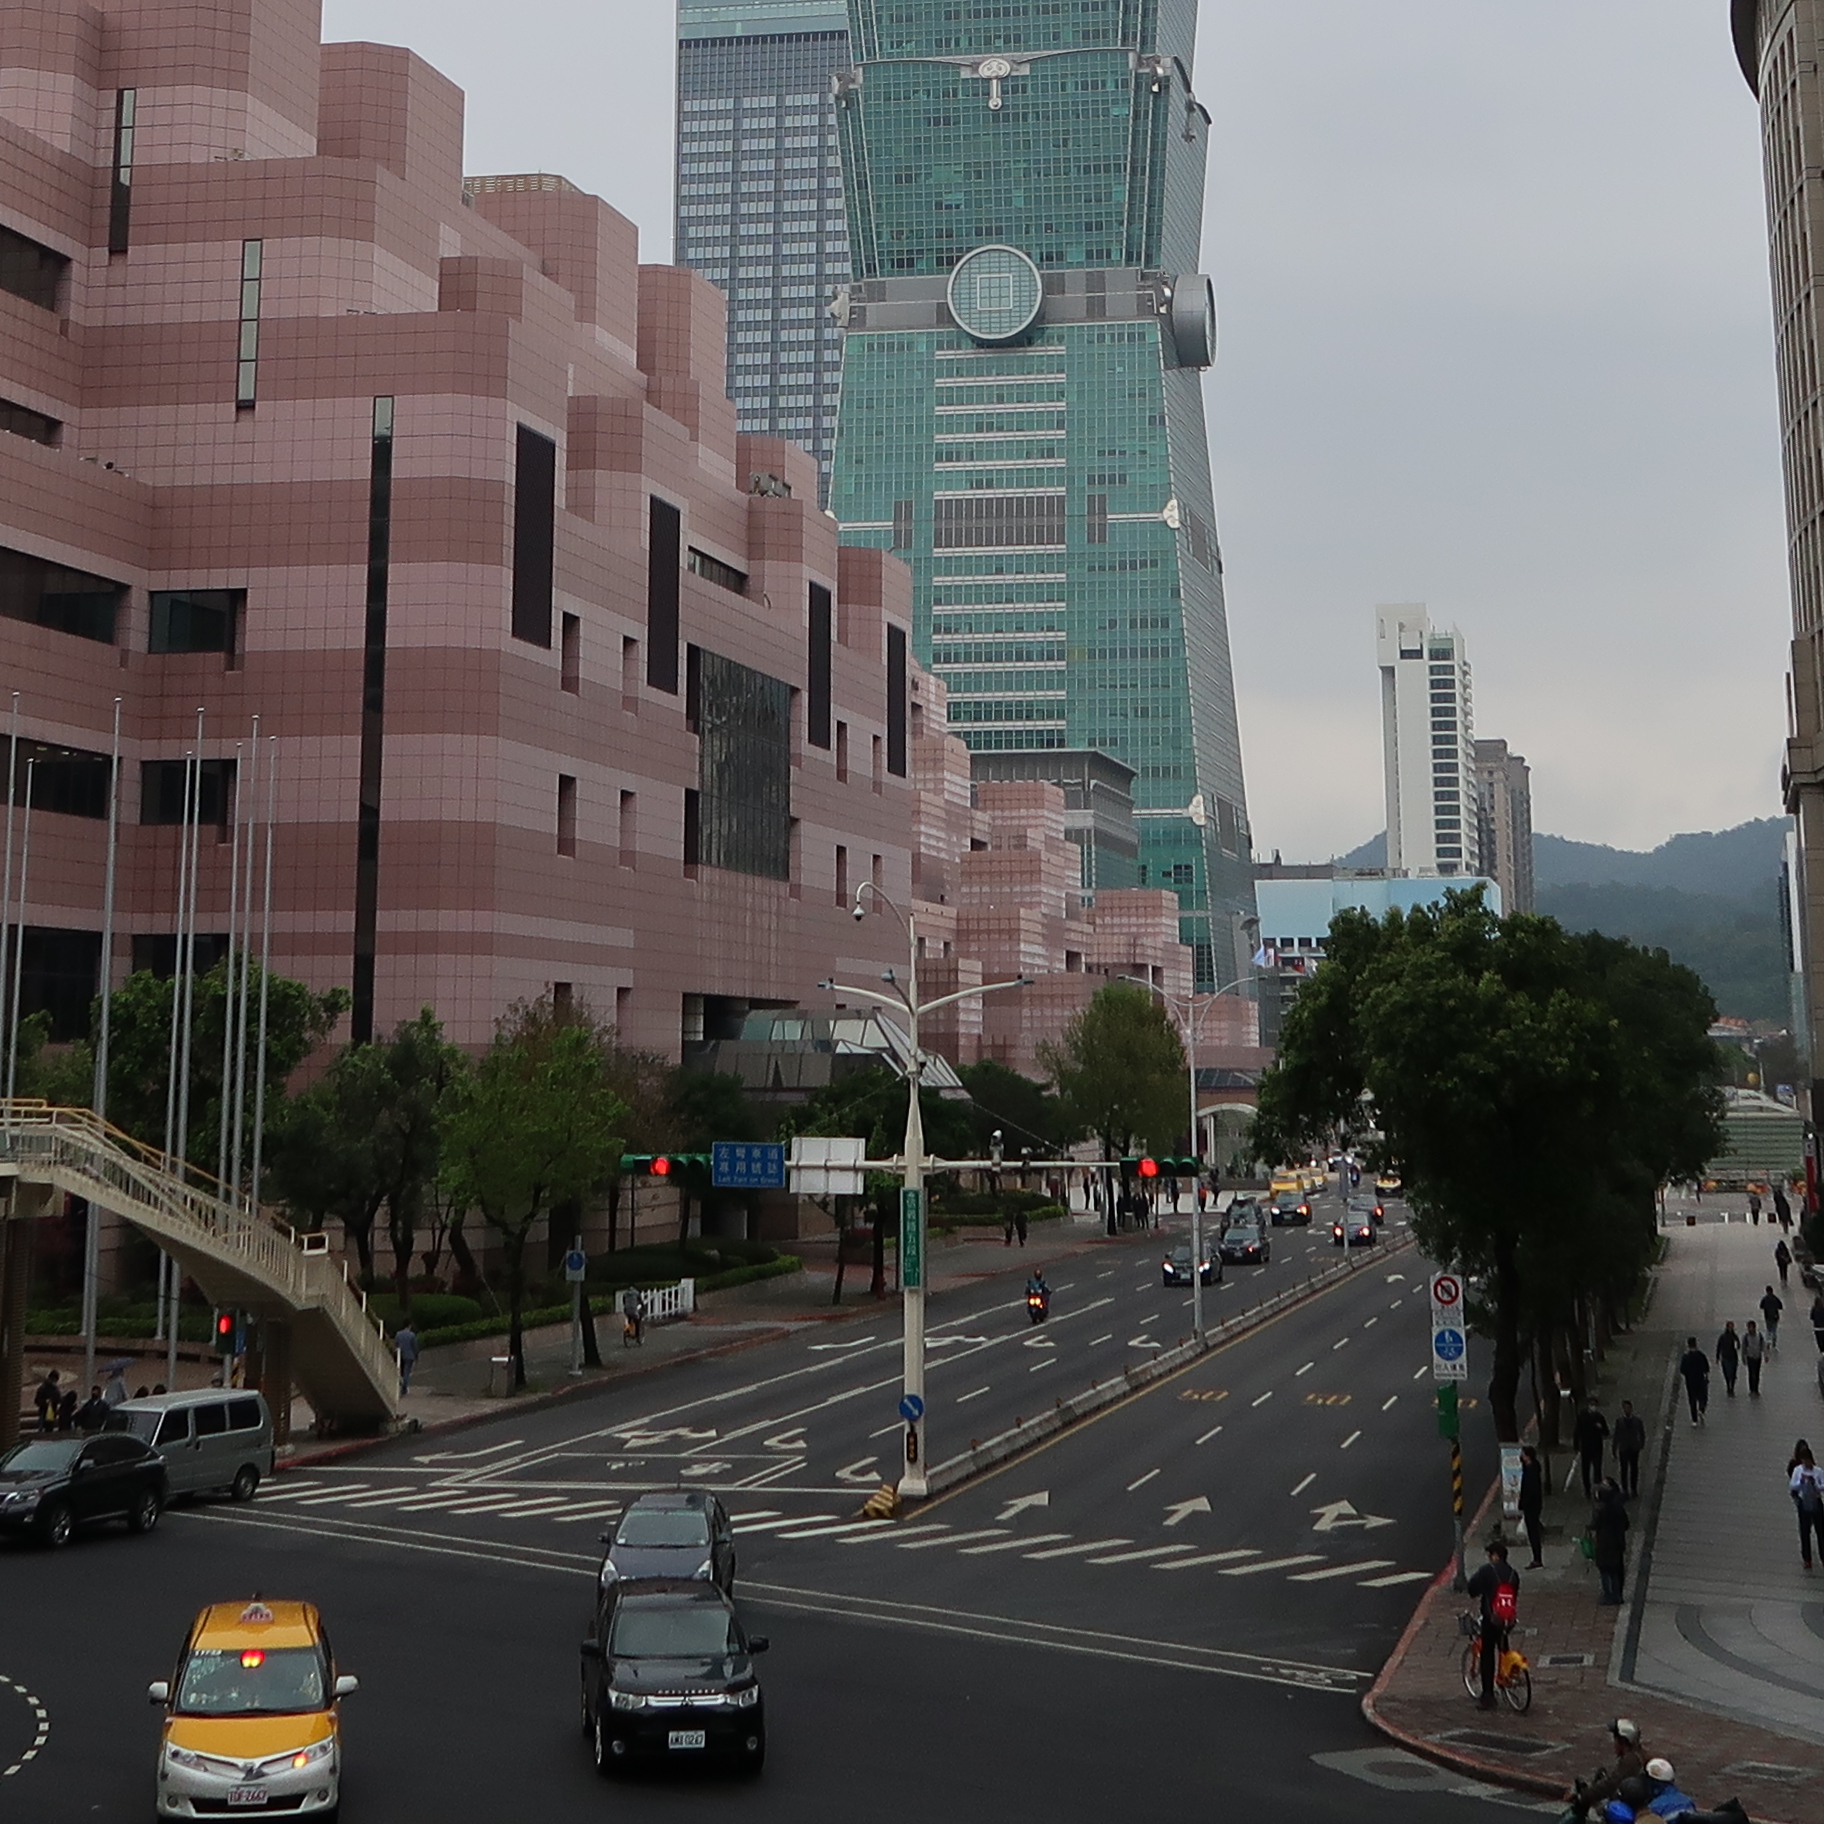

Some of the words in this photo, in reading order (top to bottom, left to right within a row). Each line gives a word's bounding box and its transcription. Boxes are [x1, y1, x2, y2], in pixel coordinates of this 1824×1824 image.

[717, 1146, 778, 1159] 左彎車道
[717, 1160, 778, 1174] 專用號誌
